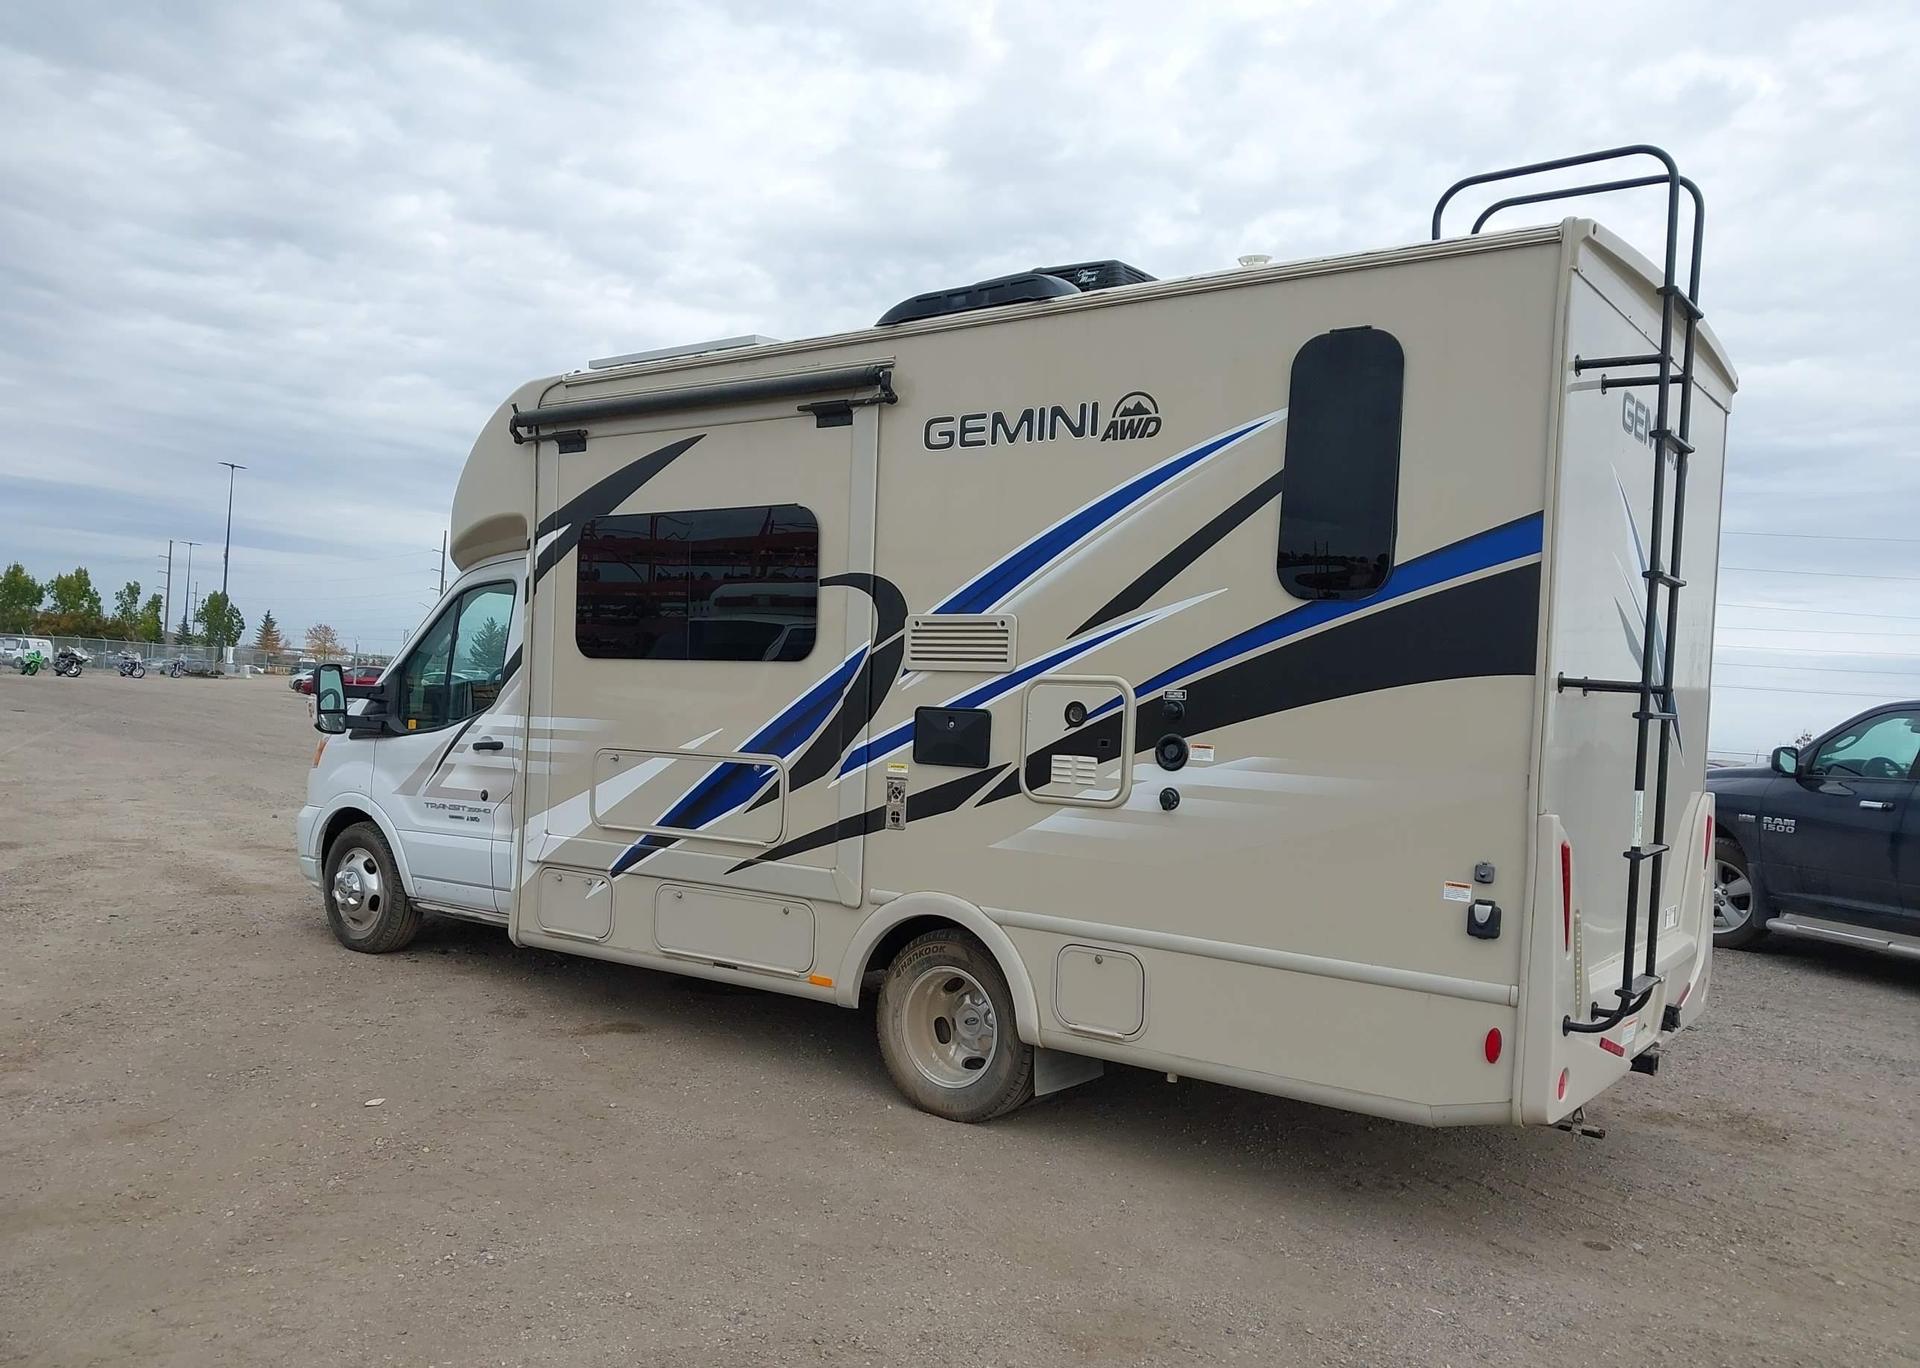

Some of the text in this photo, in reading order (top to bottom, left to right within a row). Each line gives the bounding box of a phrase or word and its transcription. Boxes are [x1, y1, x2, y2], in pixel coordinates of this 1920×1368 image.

[924, 401, 1099, 451] GEMINI
[1100, 416, 1161, 442] AWD
[424, 802, 466, 811] TRANSIT
[1763, 816, 1796, 826] RAM
[1763, 824, 1795, 833] 1500
